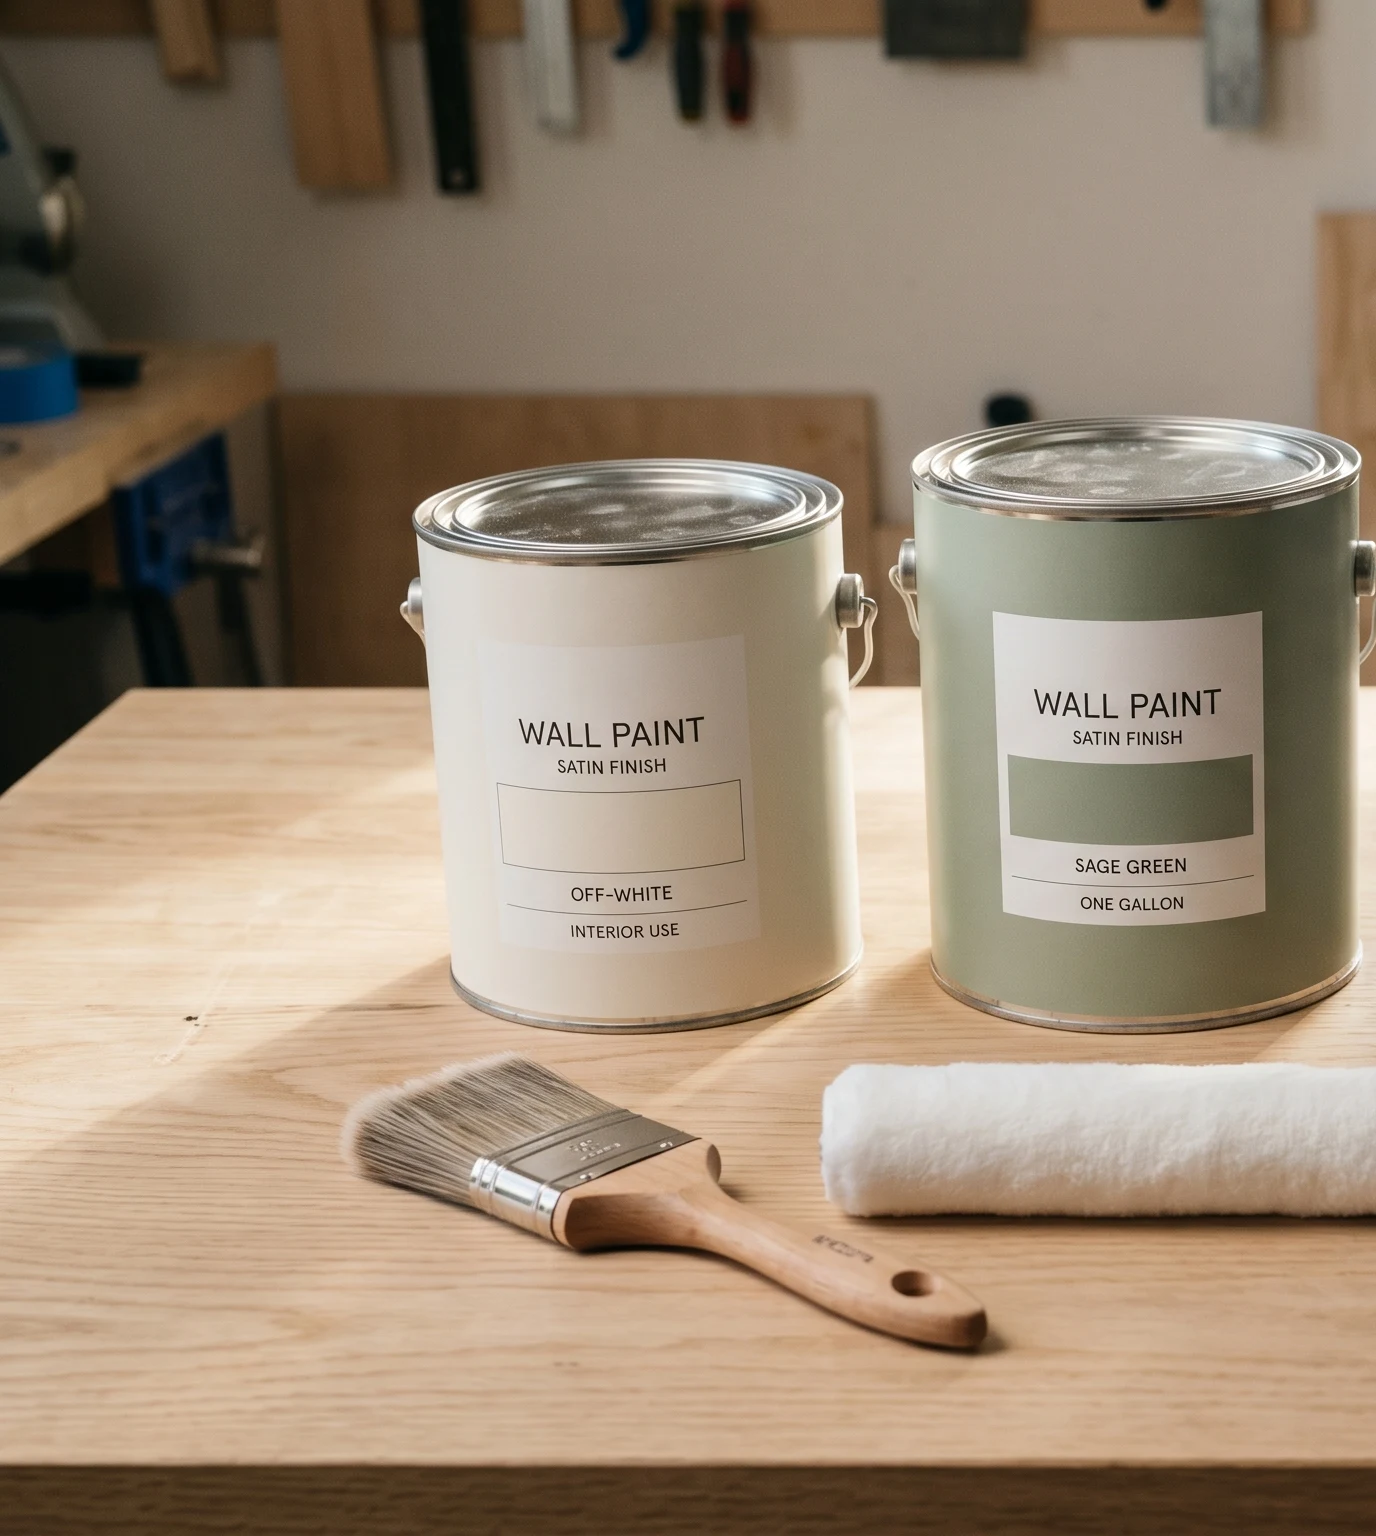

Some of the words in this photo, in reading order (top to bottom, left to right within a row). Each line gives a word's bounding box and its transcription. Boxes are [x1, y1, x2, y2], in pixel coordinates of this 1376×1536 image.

[1033, 688, 1119, 720] WALL
[1130, 688, 1222, 720] PAINT
[517, 718, 602, 749] WALL
[612, 715, 705, 748] PAINT
[1072, 730, 1120, 746] SATIN
[1126, 729, 1183, 747] FINISH
[557, 759, 604, 775] SATIN
[609, 757, 667, 775] FINISH
[1075, 857, 1121, 875] SAGE
[1126, 857, 1187, 875] GREEN
[570, 885, 673, 903] OFF-WHITE
[1080, 896, 1115, 911] ONE
[1118, 896, 1184, 912] GALLON
[570, 924, 645, 939] INTERIOR
[649, 922, 680, 938] USE
